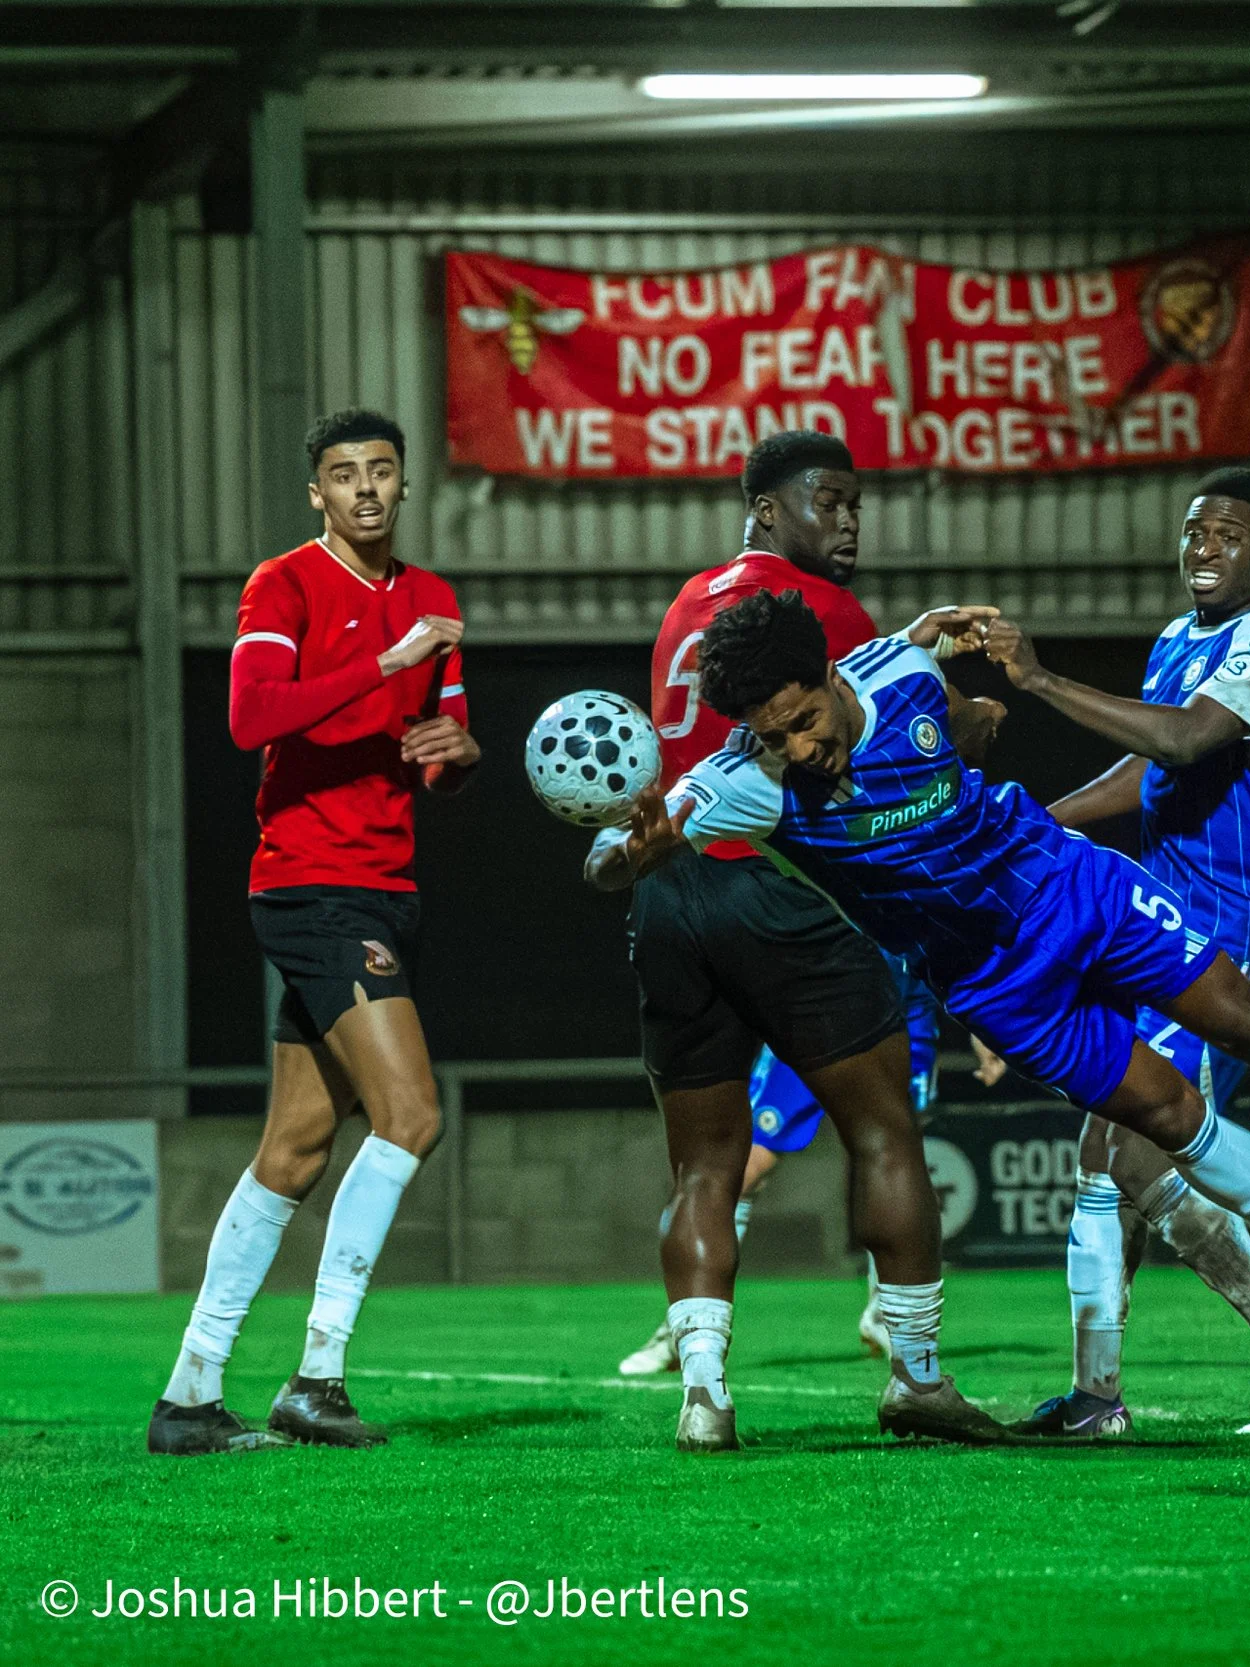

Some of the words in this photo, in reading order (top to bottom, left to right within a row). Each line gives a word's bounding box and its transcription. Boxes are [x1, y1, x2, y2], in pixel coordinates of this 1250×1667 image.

[590, 265, 775, 320] FCUM
[948, 269, 1118, 326] CLUB
[618, 334, 711, 396] NO
[926, 335, 1108, 401] HERE
[516, 407, 615, 468] WE
[646, 401, 847, 468] STAND
[659, 631, 704, 739] 5
[871, 782, 951, 837] Pinnacle
[1132, 884, 1182, 931] 5
